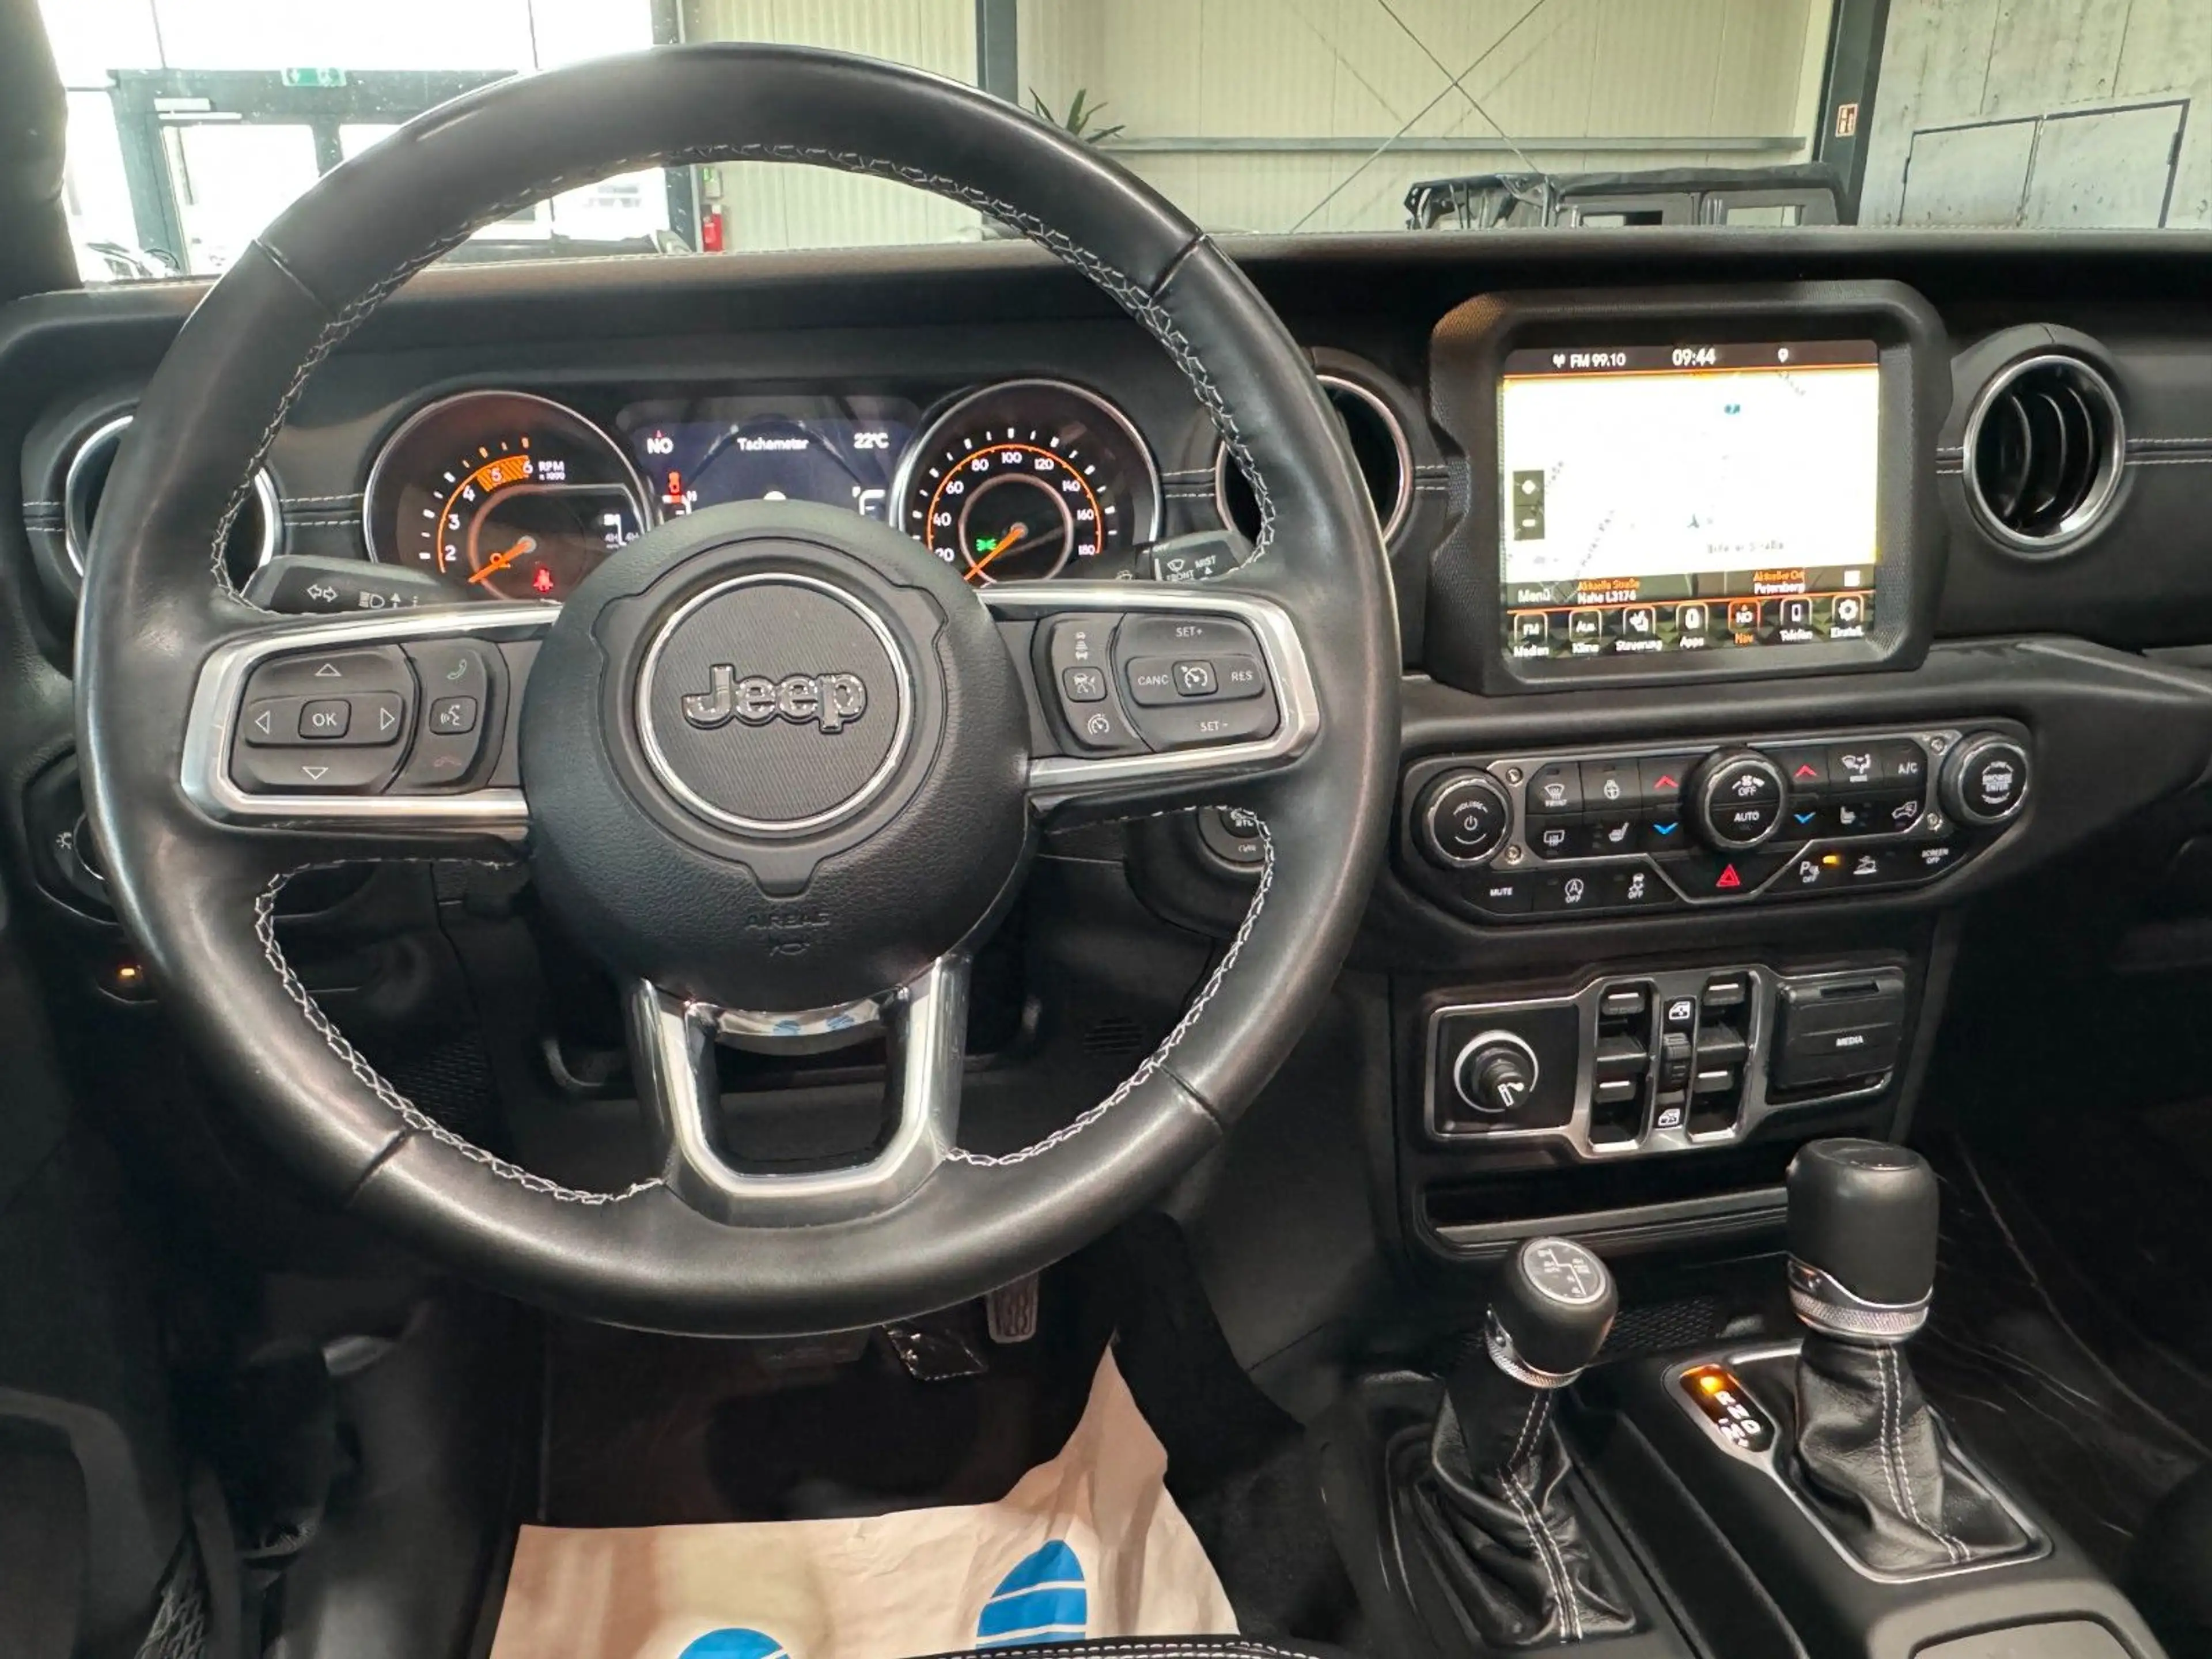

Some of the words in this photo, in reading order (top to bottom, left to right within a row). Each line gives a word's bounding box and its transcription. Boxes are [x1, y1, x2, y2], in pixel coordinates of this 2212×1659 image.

[1571, 354, 1589, 368] FM
[1592, 352, 1626, 367] 99.10
[1672, 348, 1716, 366] 09:44
[647, 438, 673, 454] NO
[737, 437, 810, 451] Tachometer
[971, 458, 989, 472] 80
[1001, 452, 1023, 464] 100
[1034, 457, 1054, 471] 120
[522, 461, 533, 474] 6
[539, 460, 565, 472] RPM
[490, 467, 502, 482] 5
[463, 484, 475, 502] 4
[945, 480, 964, 494] 60
[1062, 480, 1081, 493] 140
[448, 513, 460, 531] 3
[933, 512, 952, 527] 40
[1076, 509, 1094, 521] 160
[445, 545, 456, 560] 2
[1078, 544, 1095, 555] 180
[1194, 555, 1217, 569] MIST
[1679, 635, 1705, 649] Apps
[1138, 673, 1170, 687] CANC
[1230, 671, 1254, 682] RES
[681, 662, 869, 734] Jeep
[311, 712, 338, 728] OK
[1897, 762, 1918, 775] A/C
[1738, 786, 1757, 797] OFF
[1734, 811, 1760, 823] AUTO
[1921, 848, 1949, 858] SCREEN
[1925, 855, 1941, 865] OFF
[1490, 887, 1513, 897] MUTE
[1565, 893, 1582, 903] OFF
[1628, 890, 1644, 899] OFF
[1835, 1035, 1863, 1047] MEDIA
[1714, 1390, 1737, 1406] R
[1727, 1403, 1751, 1419] N
[1740, 1419, 1761, 1434] D
